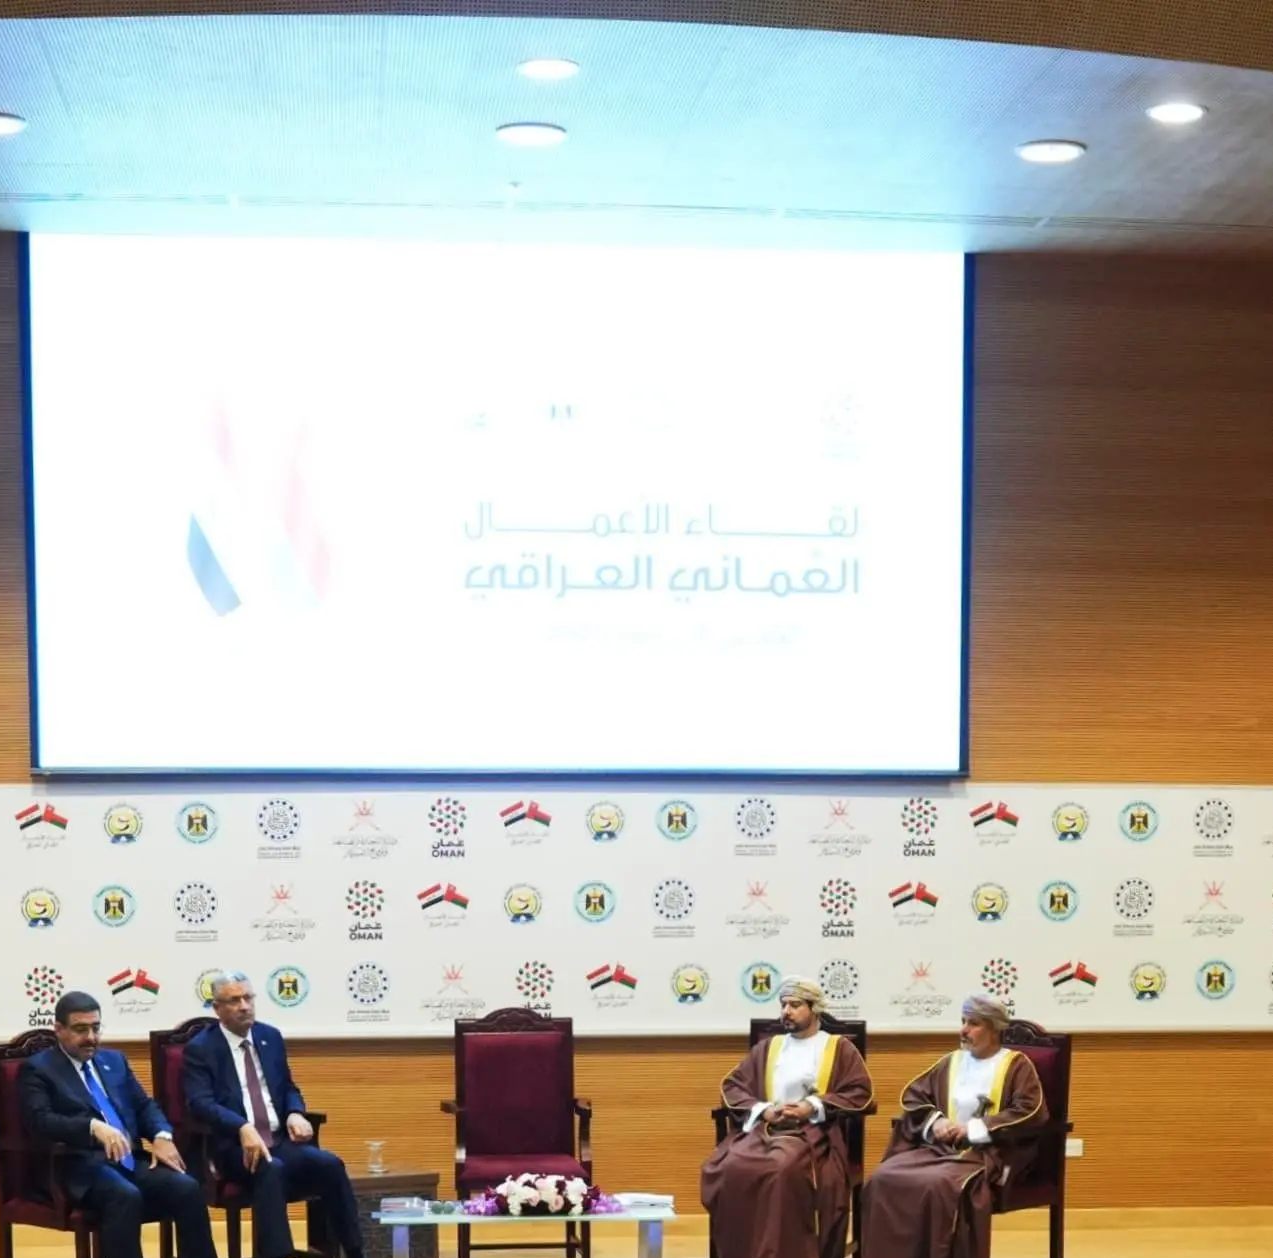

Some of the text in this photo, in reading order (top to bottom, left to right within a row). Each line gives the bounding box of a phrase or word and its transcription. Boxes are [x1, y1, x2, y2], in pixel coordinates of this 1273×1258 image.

[464, 549, 654, 600] العراقي
[431, 849, 466, 858] OMAN
[903, 849, 936, 857] OMAN
[349, 932, 384, 941] OMAN
[822, 930, 855, 938] OMAN
[29, 1018, 55, 1027] OMA
